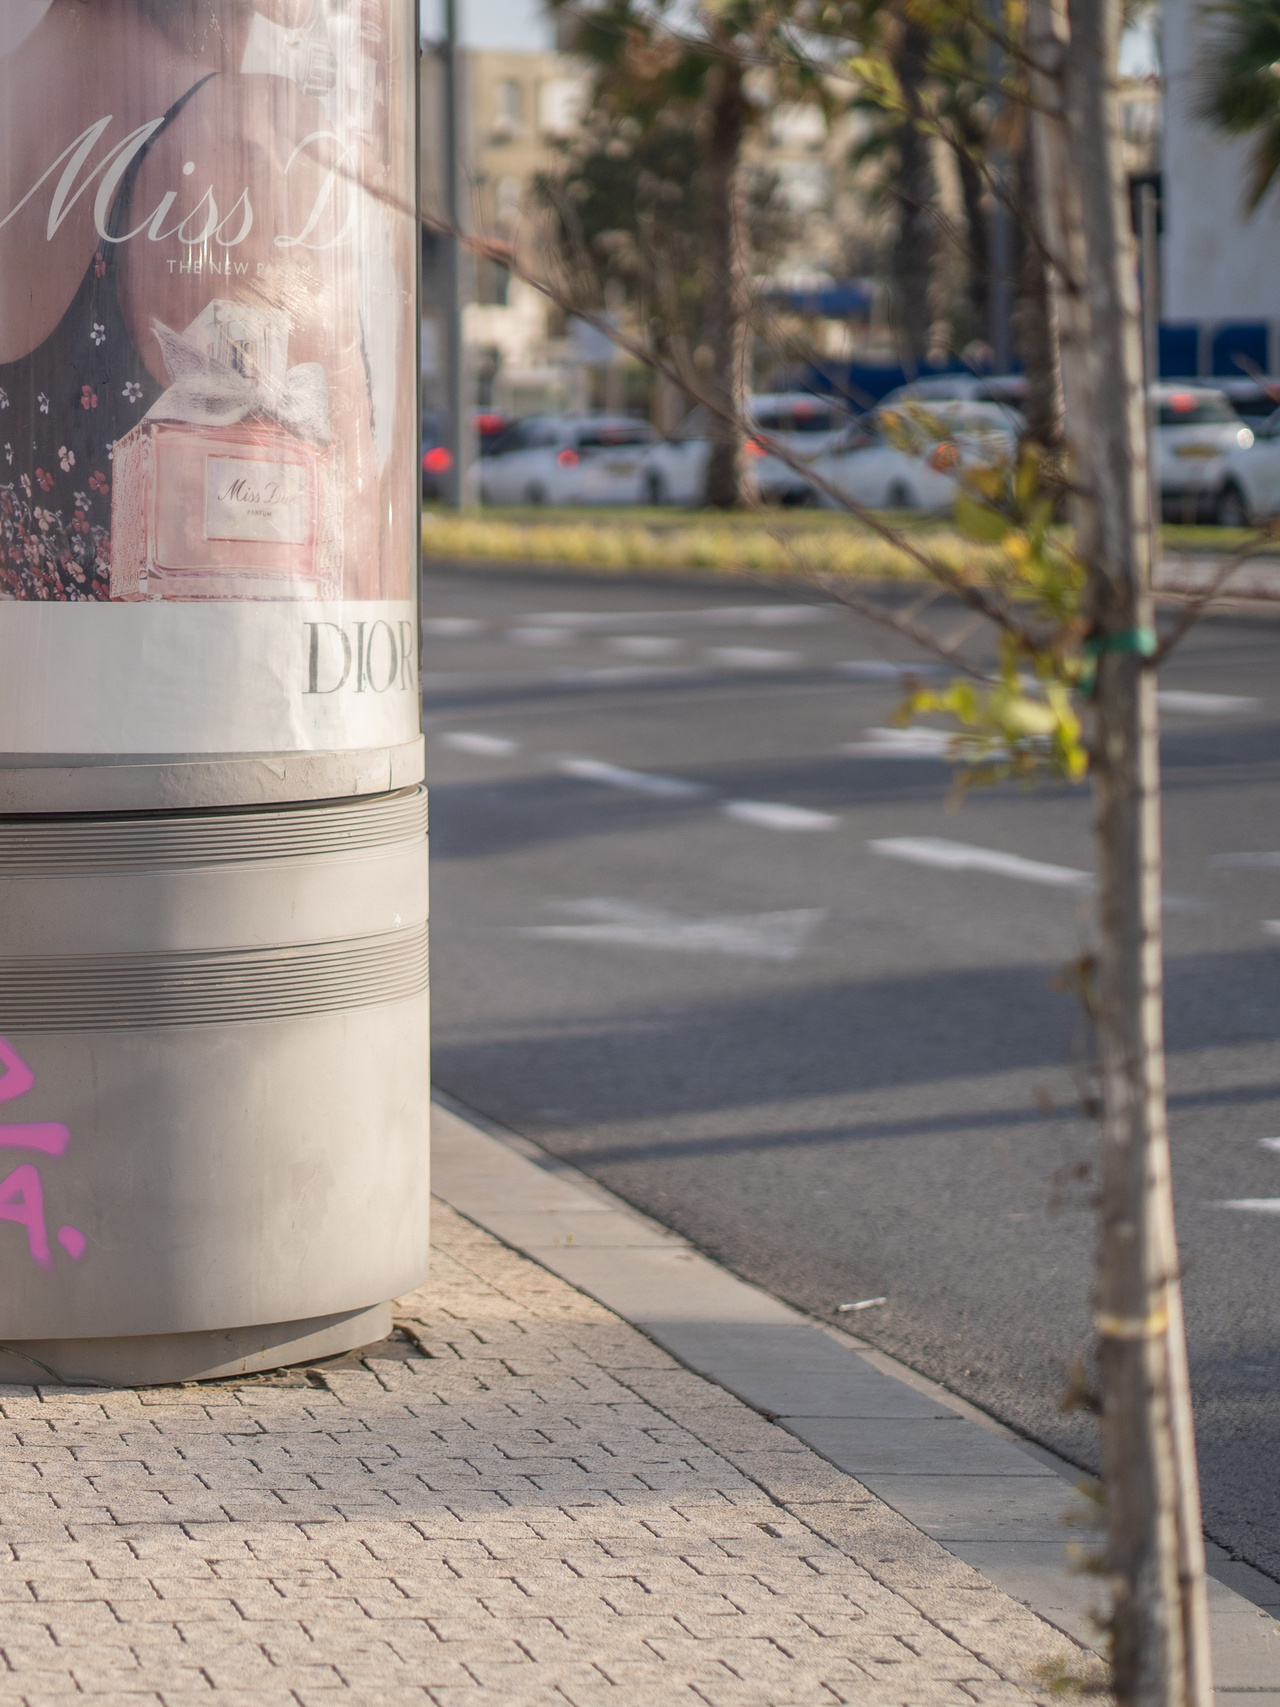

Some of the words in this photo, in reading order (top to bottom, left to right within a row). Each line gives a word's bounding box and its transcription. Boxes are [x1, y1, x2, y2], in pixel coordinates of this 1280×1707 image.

[166, 260, 203, 275] THE
[210, 261, 249, 275] NEW
[217, 478, 260, 504] Miss
[246, 509, 273, 517] PARFUM
[301, 620, 416, 695] DIOR
